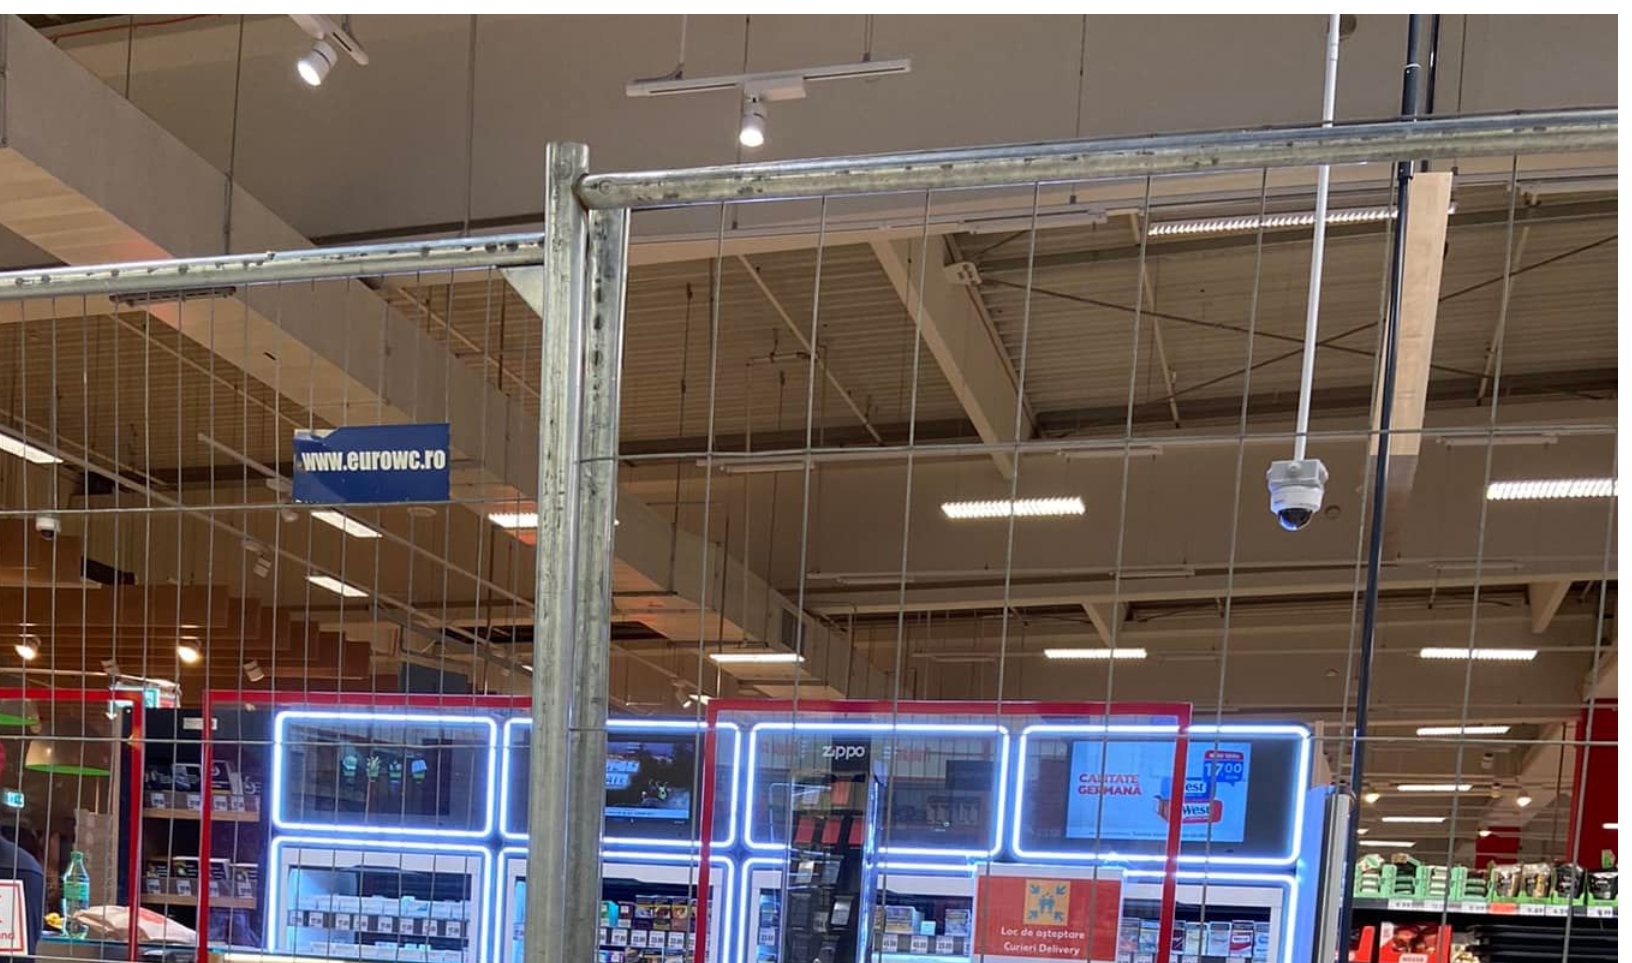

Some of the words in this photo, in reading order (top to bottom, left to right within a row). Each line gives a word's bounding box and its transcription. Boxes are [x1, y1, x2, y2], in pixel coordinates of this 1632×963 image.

[301, 450, 446, 471] www.eurowc.ro
[1184, 781, 1206, 793] est
[1001, 926, 1019, 936] Loc
[1020, 928, 1033, 938] de
[1003, 942, 1037, 953] Curieri
[1039, 943, 1081, 956] Delivery
